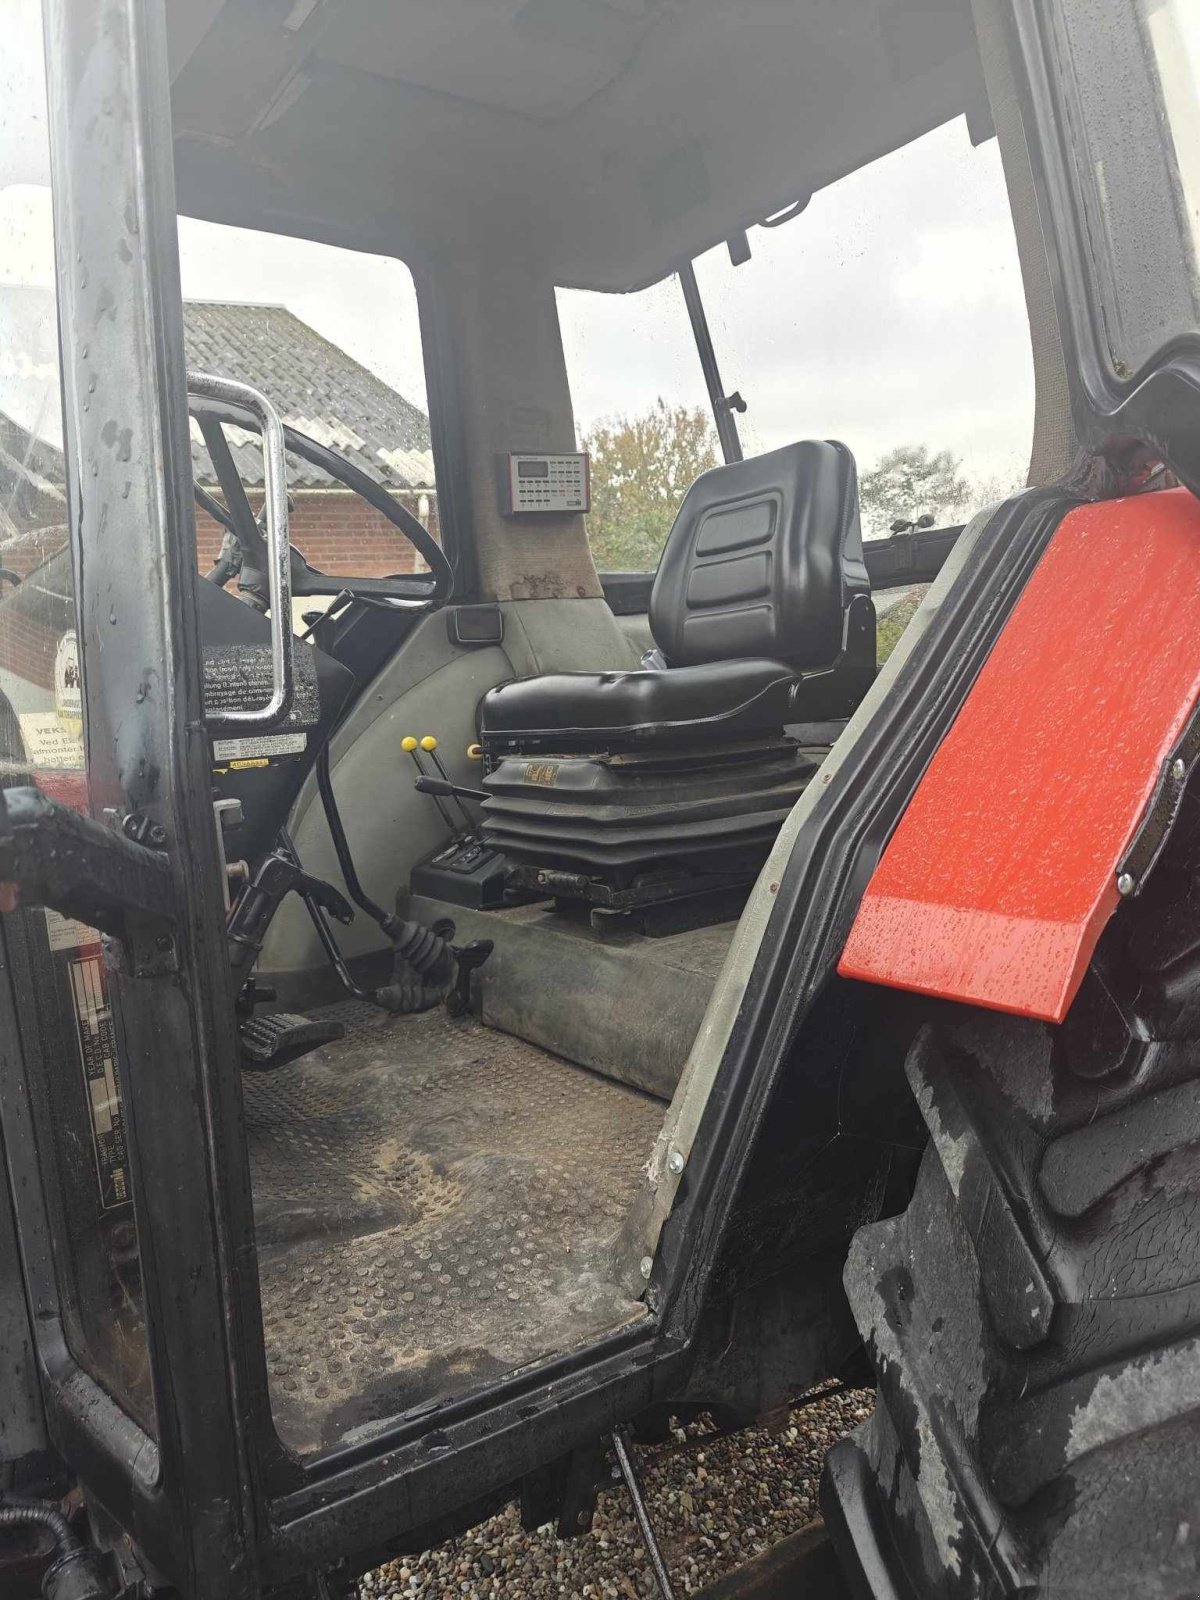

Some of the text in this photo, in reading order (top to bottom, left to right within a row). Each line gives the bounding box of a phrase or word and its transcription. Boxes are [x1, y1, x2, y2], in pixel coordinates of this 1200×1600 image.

[81, 1020, 96, 1076] YEAR OF MAKE
[99, 1020, 110, 1058] CAB CODE
[98, 1134, 107, 1165] TRACTOR
[108, 1145, 116, 1163] TYPE
